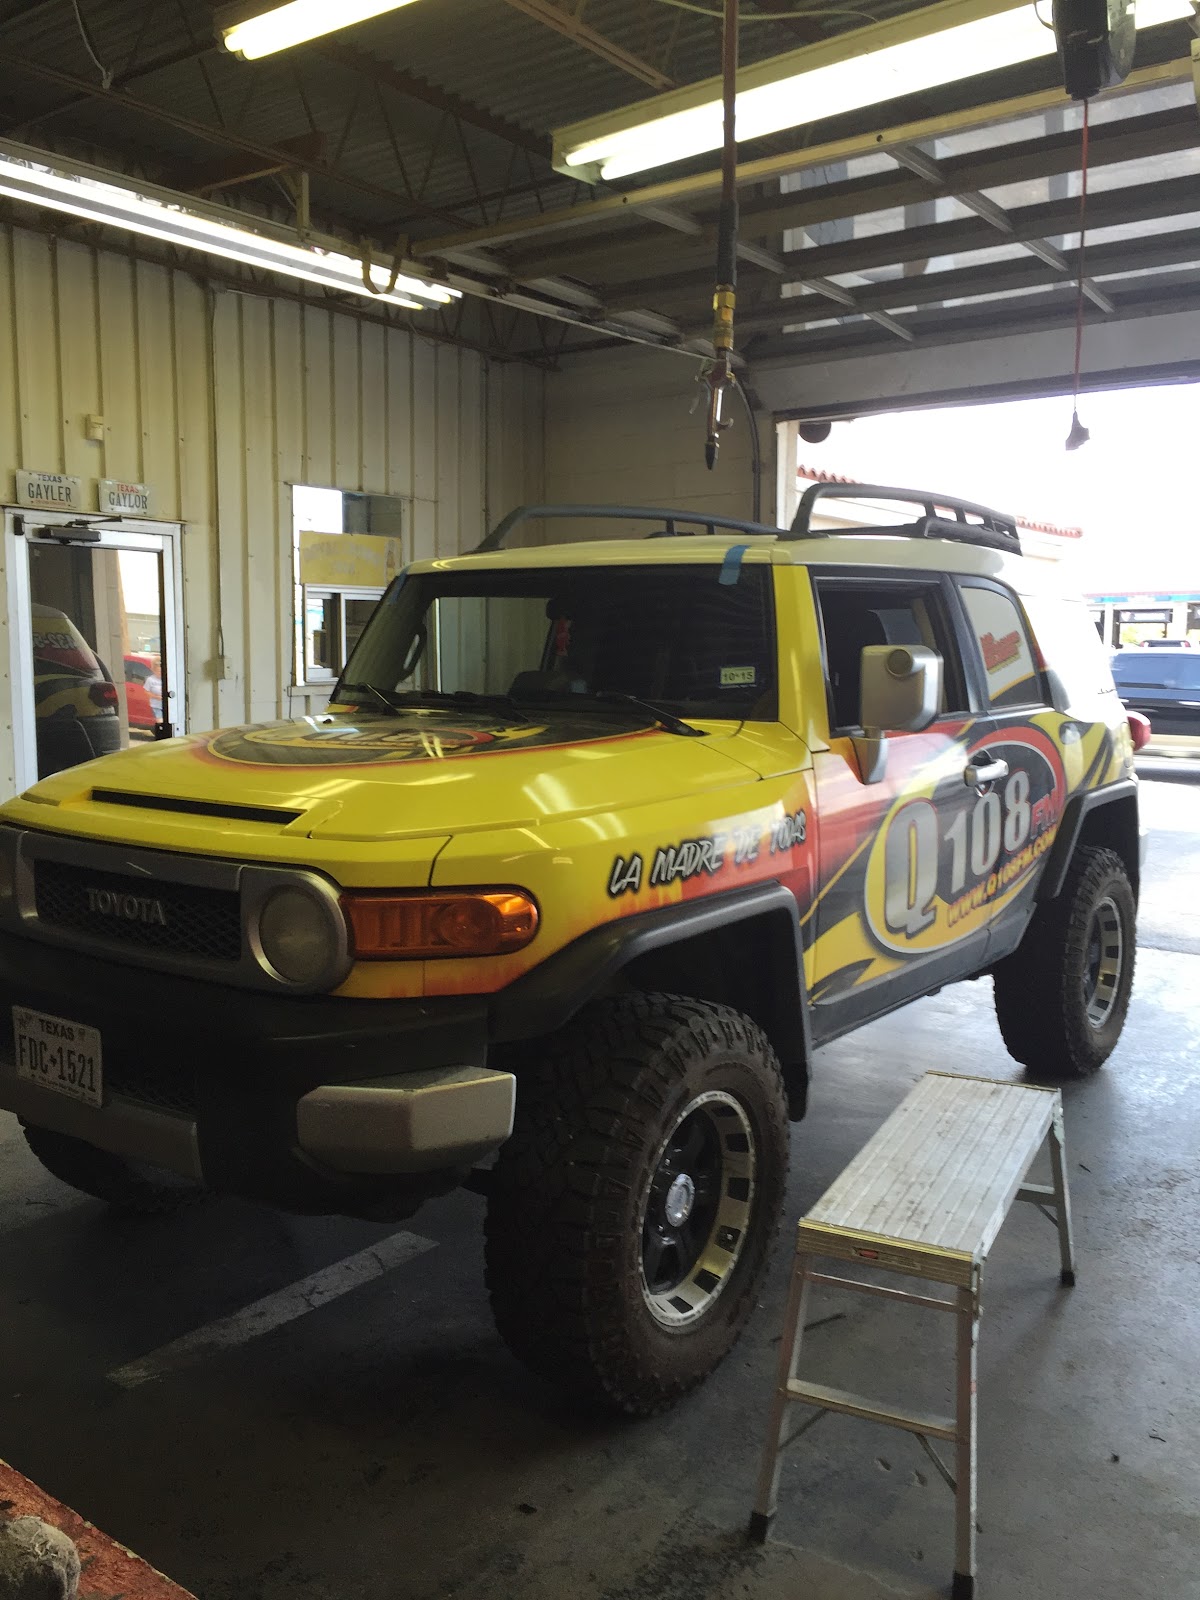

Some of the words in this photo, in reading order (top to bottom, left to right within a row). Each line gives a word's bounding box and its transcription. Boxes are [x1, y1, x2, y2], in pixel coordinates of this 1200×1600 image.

[37, 473, 63, 484] TEXAS
[116, 483, 140, 494] TEXAS
[28, 482, 72, 503] GAYLER
[108, 491, 148, 509] GAYLOR
[608, 853, 643, 895] LA
[651, 836, 724, 885] MADRE
[734, 825, 761, 865] DE
[885, 770, 1030, 938] Q108
[87, 887, 167, 926] TOYOTA
[39, 1018, 75, 1041] TEXAS
